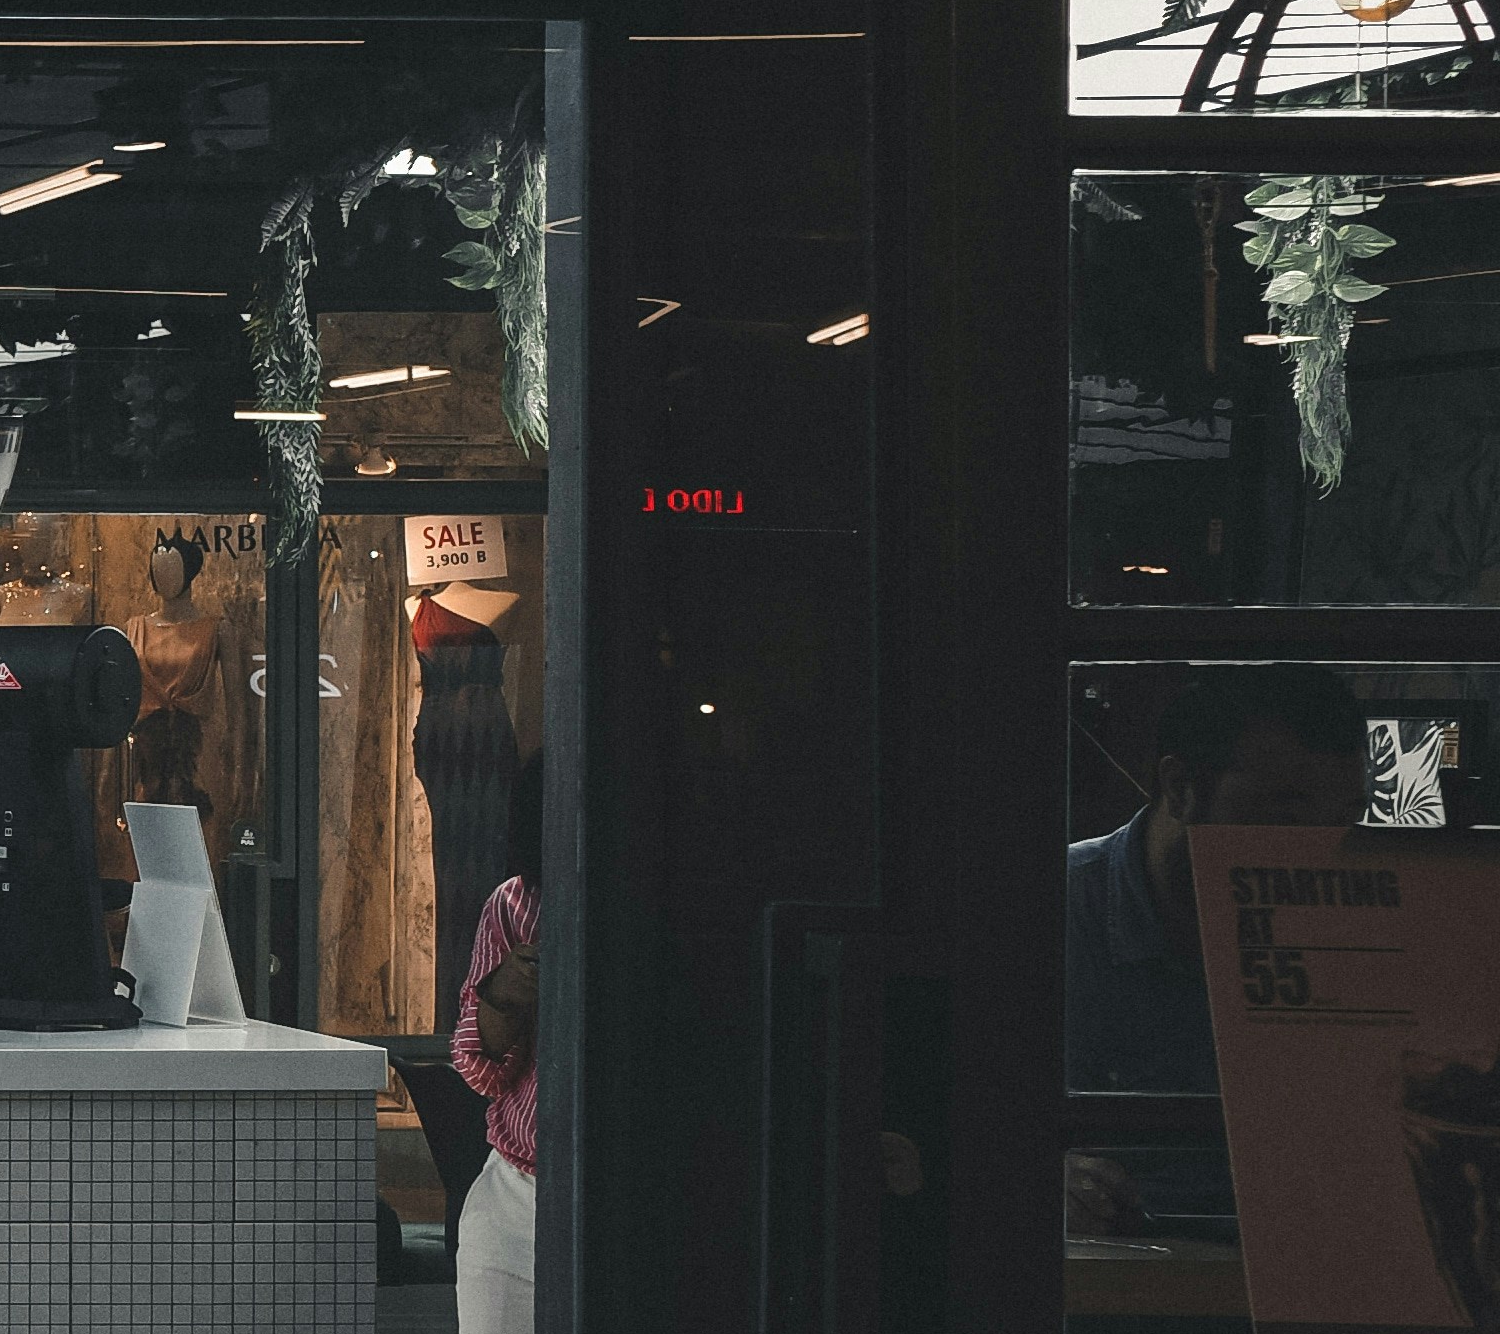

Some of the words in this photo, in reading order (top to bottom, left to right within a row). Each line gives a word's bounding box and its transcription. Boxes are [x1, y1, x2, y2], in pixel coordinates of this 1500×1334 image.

[423, 521, 485, 550] SALE
[426, 551, 469, 568] 3,900
[1230, 867, 1402, 908] STARTING
[1238, 907, 1275, 946] AT
[1240, 950, 1311, 1006] 55
